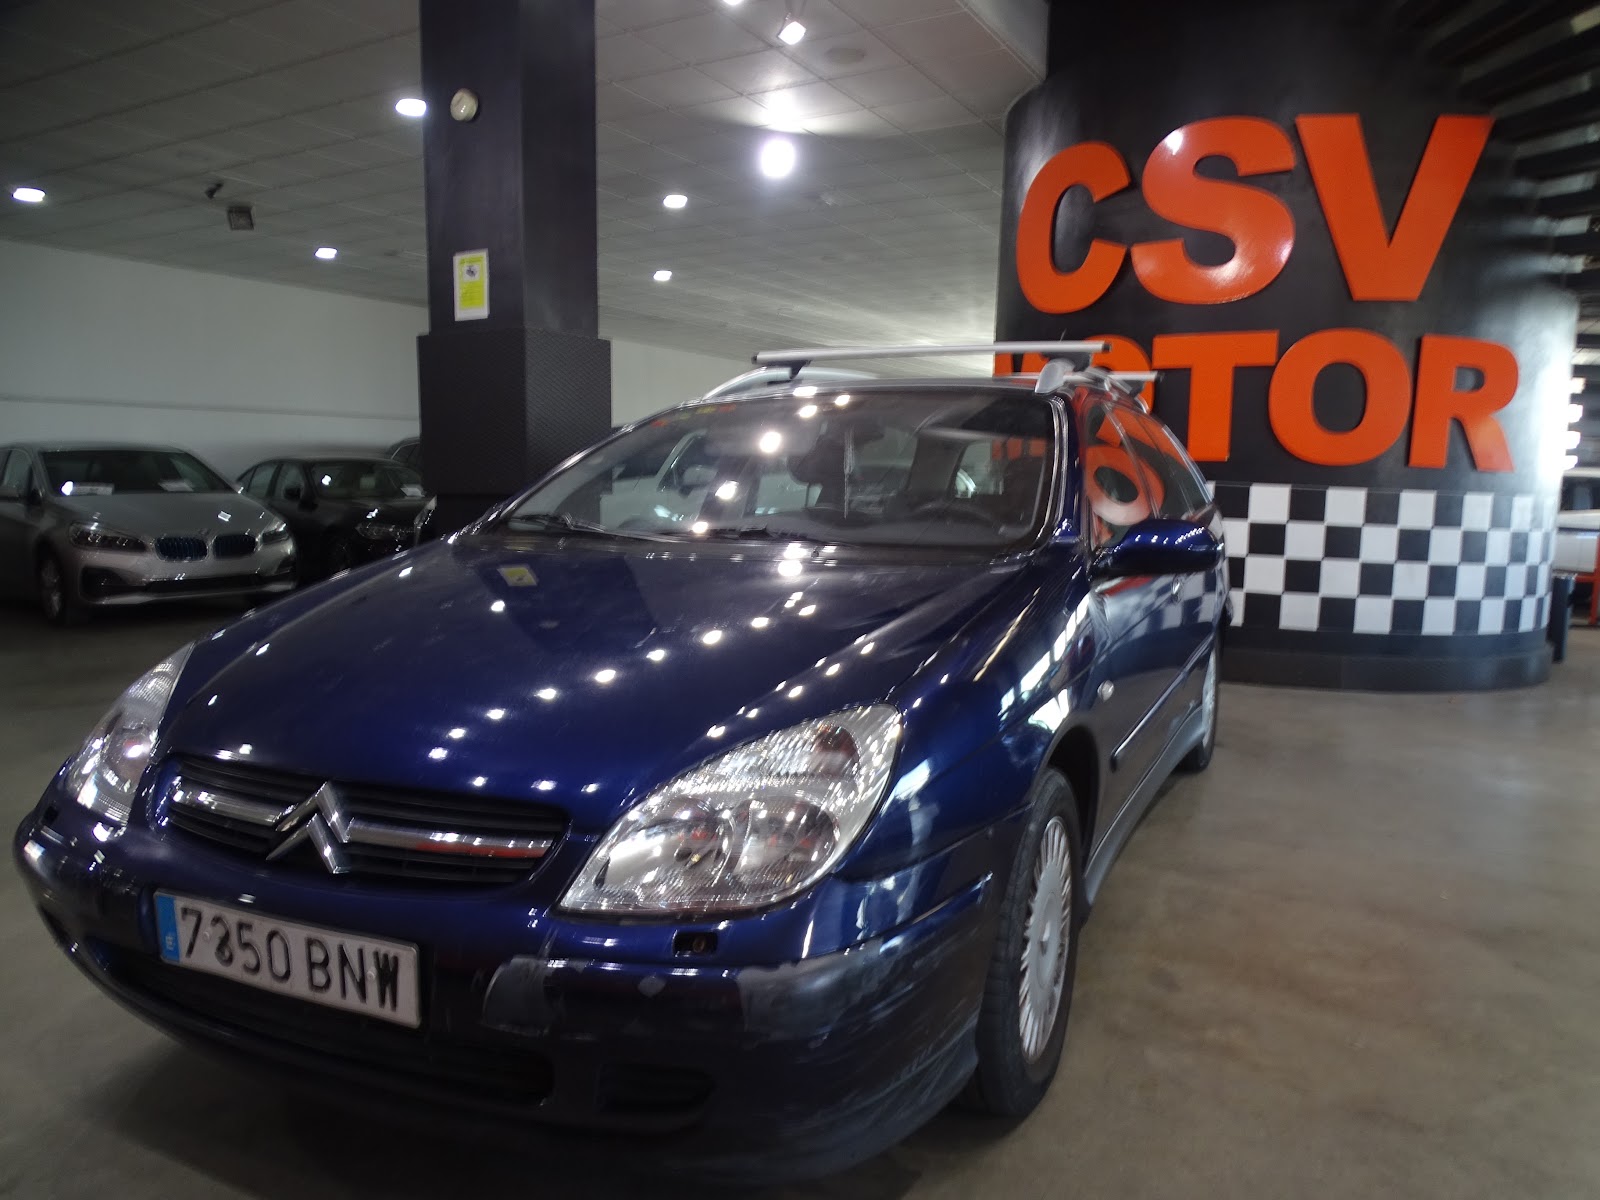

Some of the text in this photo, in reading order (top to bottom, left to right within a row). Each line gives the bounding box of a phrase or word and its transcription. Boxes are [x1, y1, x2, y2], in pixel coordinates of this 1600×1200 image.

[1016, 113, 1496, 314] CSV
[994, 328, 1518, 471] TOR
[304, 935, 399, 1012] BNW
